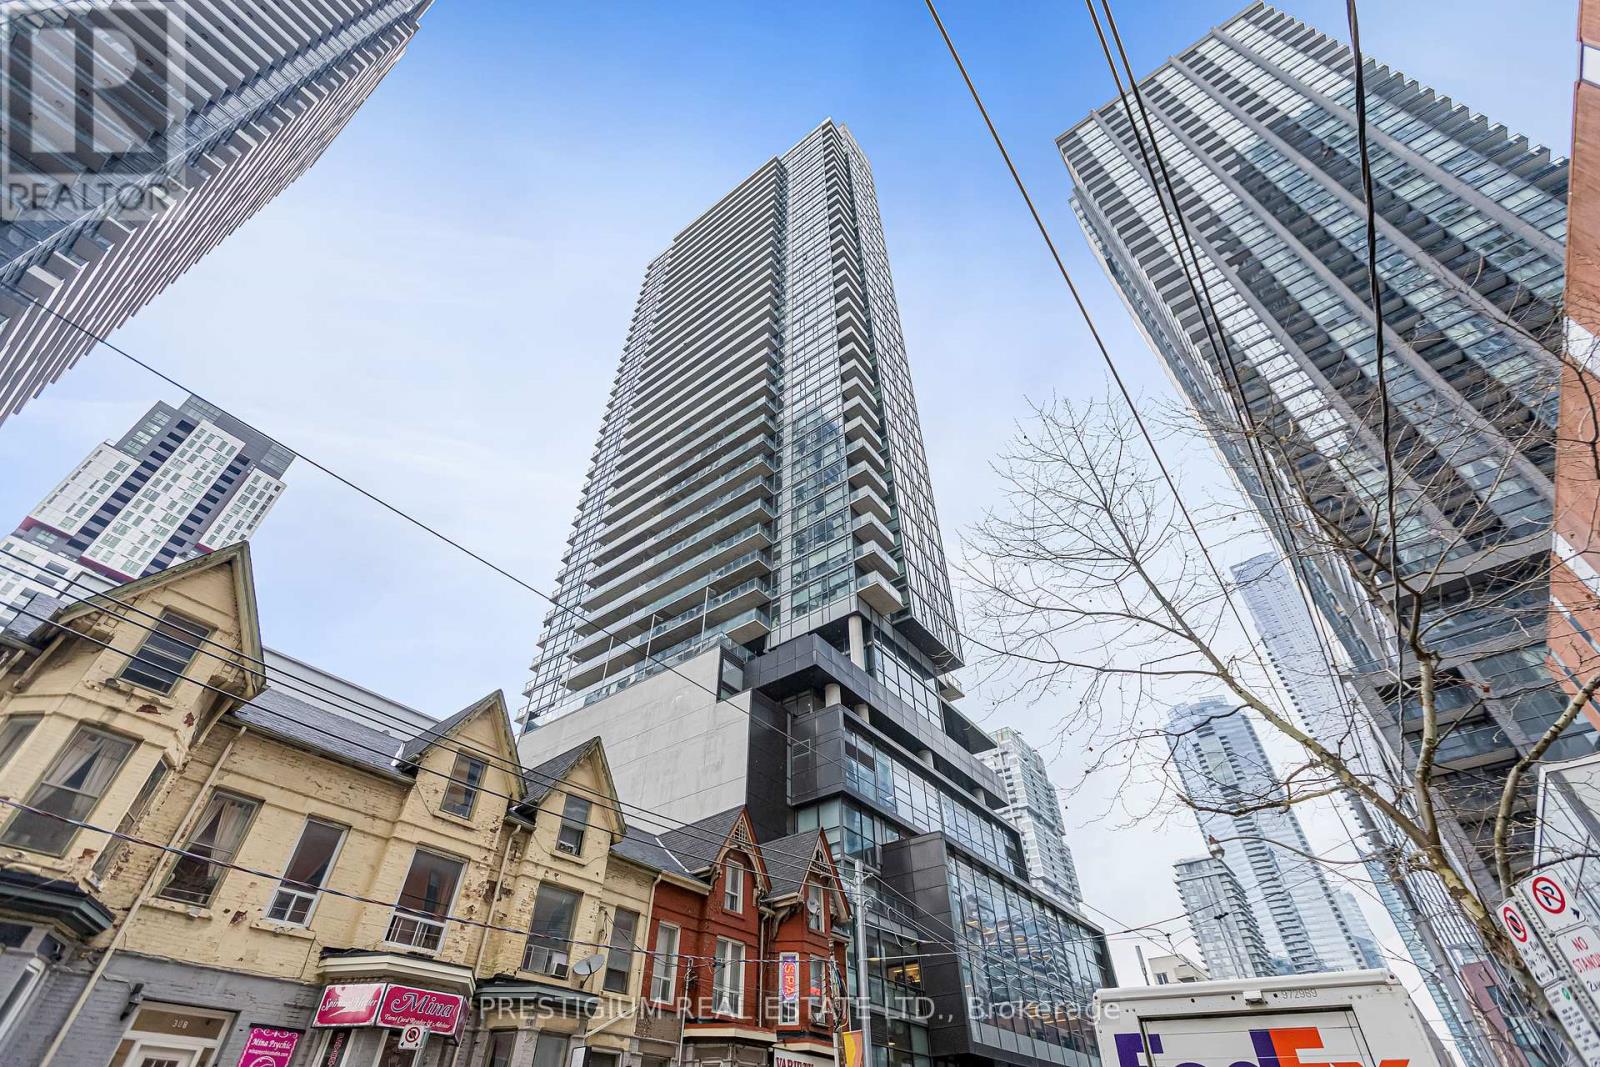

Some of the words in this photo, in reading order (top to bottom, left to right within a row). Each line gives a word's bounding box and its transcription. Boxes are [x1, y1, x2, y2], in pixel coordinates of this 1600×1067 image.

[1571, 936, 1589, 952] NO
[783, 964, 795, 997] SPA
[390, 992, 454, 1018] Mina
